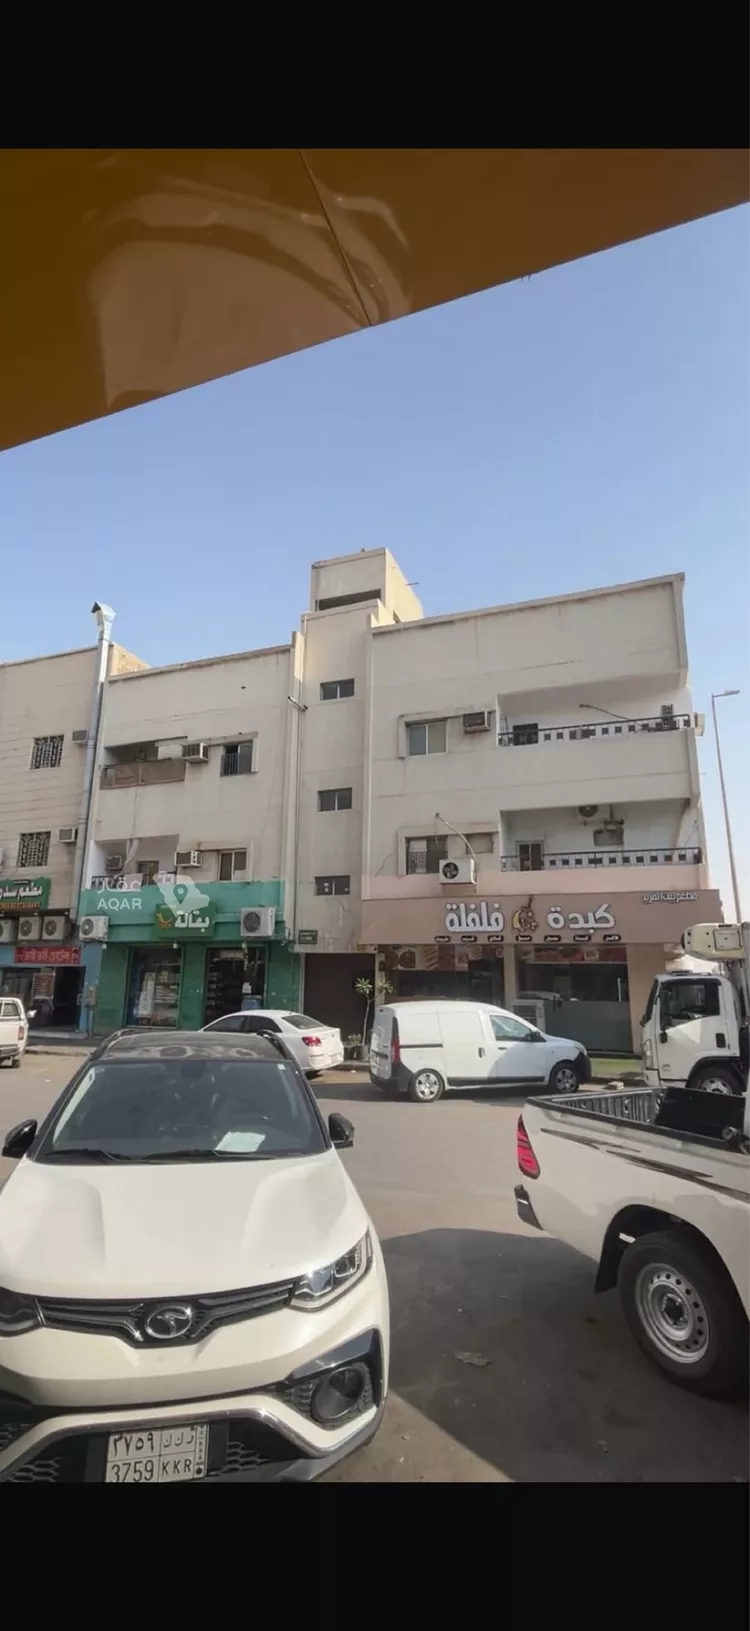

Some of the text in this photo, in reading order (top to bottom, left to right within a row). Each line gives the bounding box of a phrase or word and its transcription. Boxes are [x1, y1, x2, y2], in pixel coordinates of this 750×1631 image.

[174, 910, 210, 933] بقالة
[445, 901, 615, 934] كبدة فلفلة
[113, 1432, 155, 1457] ٣٧٥٩
[110, 1458, 193, 1483] 3759 KKR
